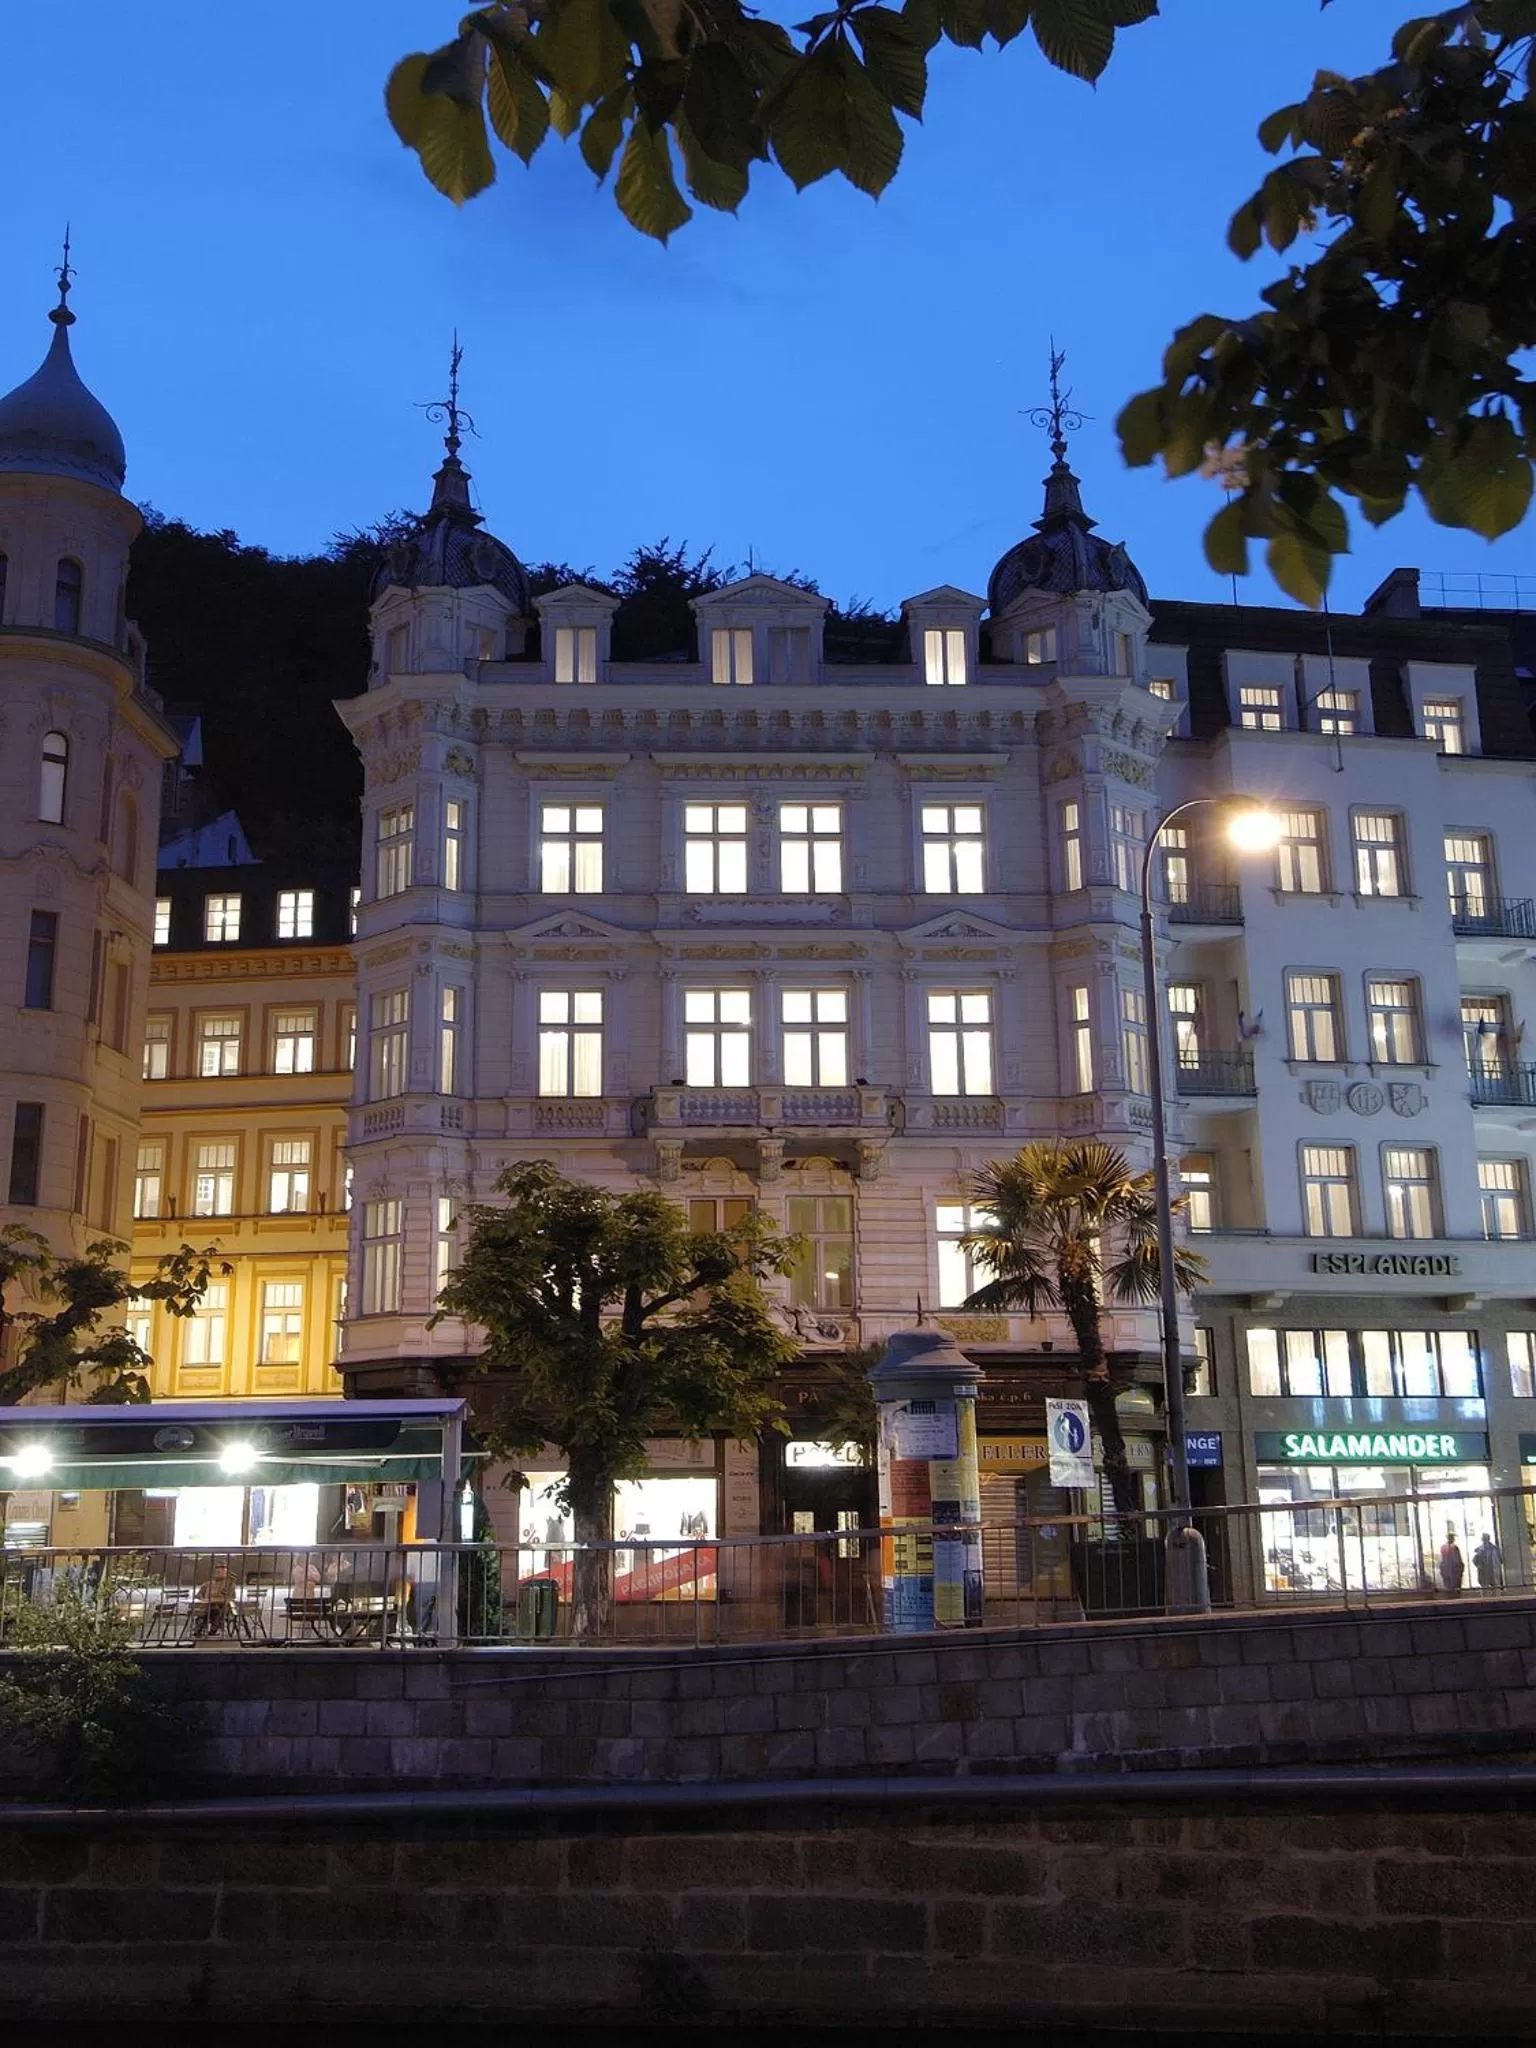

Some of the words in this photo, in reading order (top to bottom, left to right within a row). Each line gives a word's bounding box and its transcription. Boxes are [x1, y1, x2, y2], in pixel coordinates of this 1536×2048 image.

[1312, 1253, 1463, 1276] ESPLANADE
[982, 1445, 1046, 1460] ELLER
[1187, 1438, 1217, 1450] NGE
[1285, 1434, 1458, 1457] SALAMANDER
